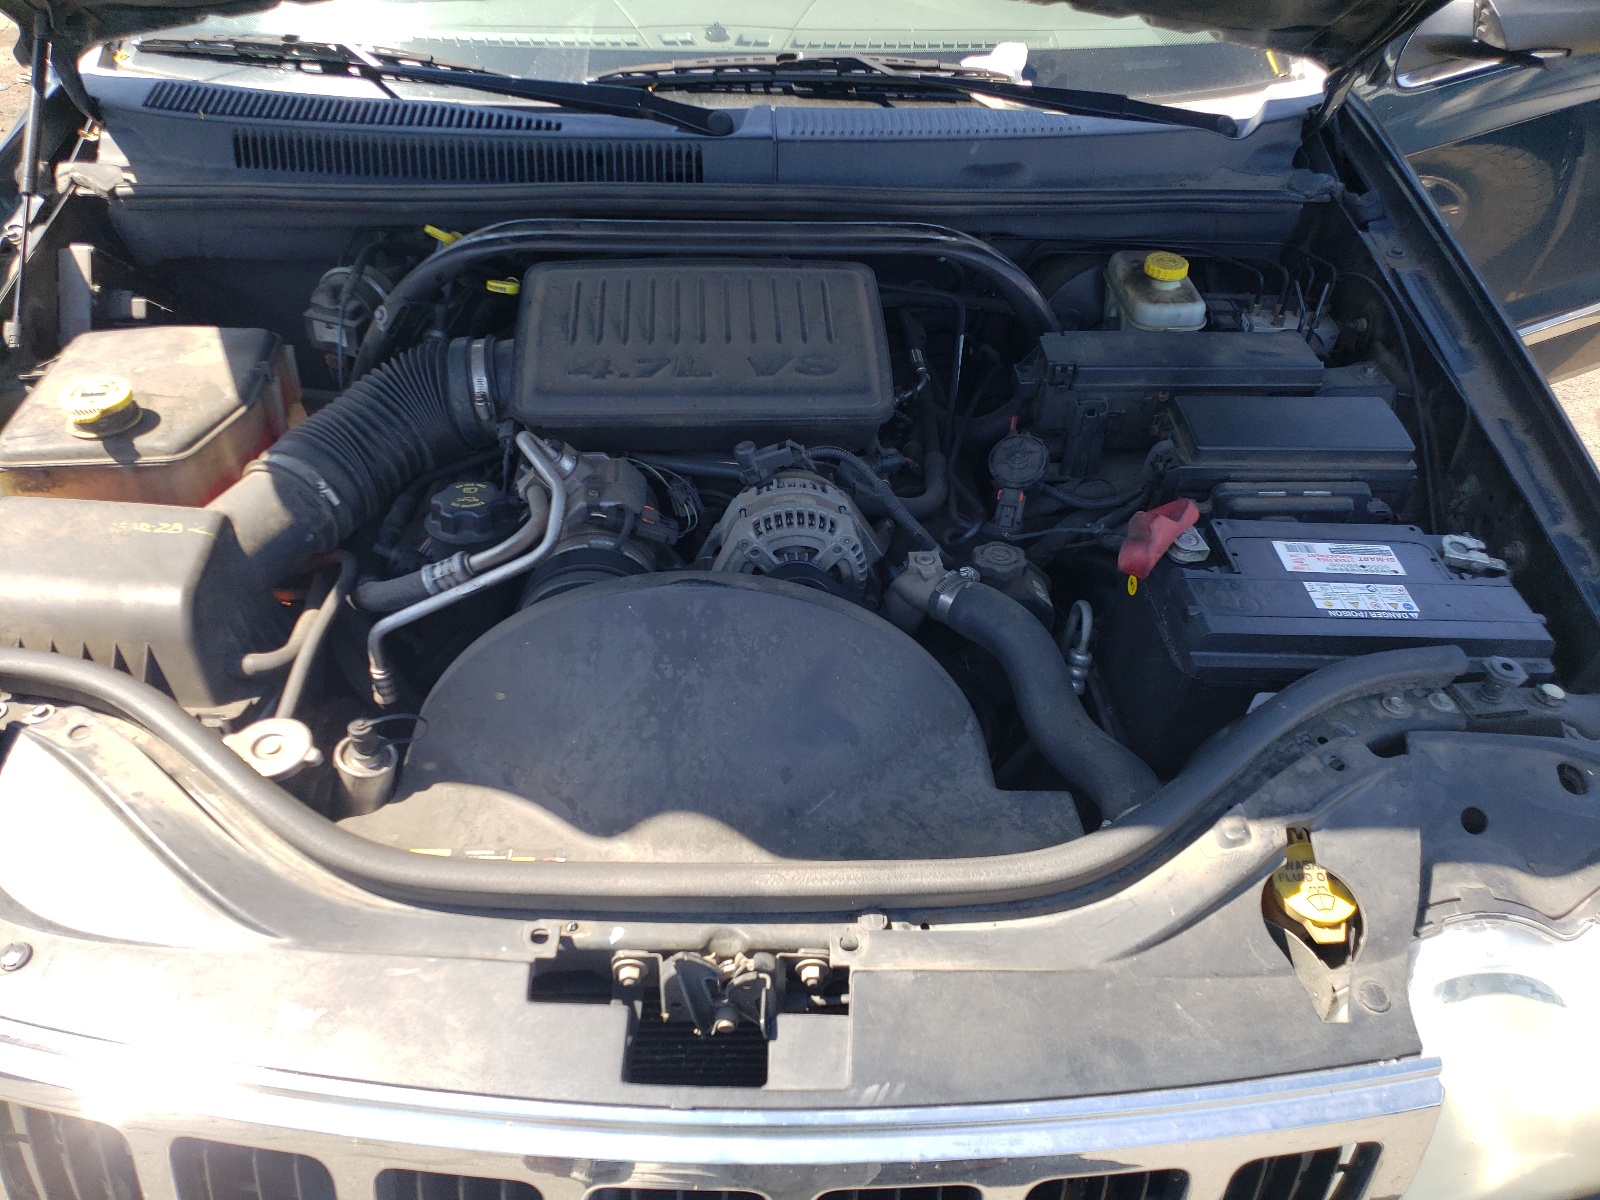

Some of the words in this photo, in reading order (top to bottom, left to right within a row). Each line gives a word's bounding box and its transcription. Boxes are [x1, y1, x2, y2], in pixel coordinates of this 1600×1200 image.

[567, 356, 714, 379] 4.7L
[746, 353, 838, 377] V8
[1328, 610, 1364, 618] POISON
[1370, 611, 1410, 619] DANGER
[1285, 860, 1321, 870] WASH
[1278, 872, 1313, 882] FLUID
